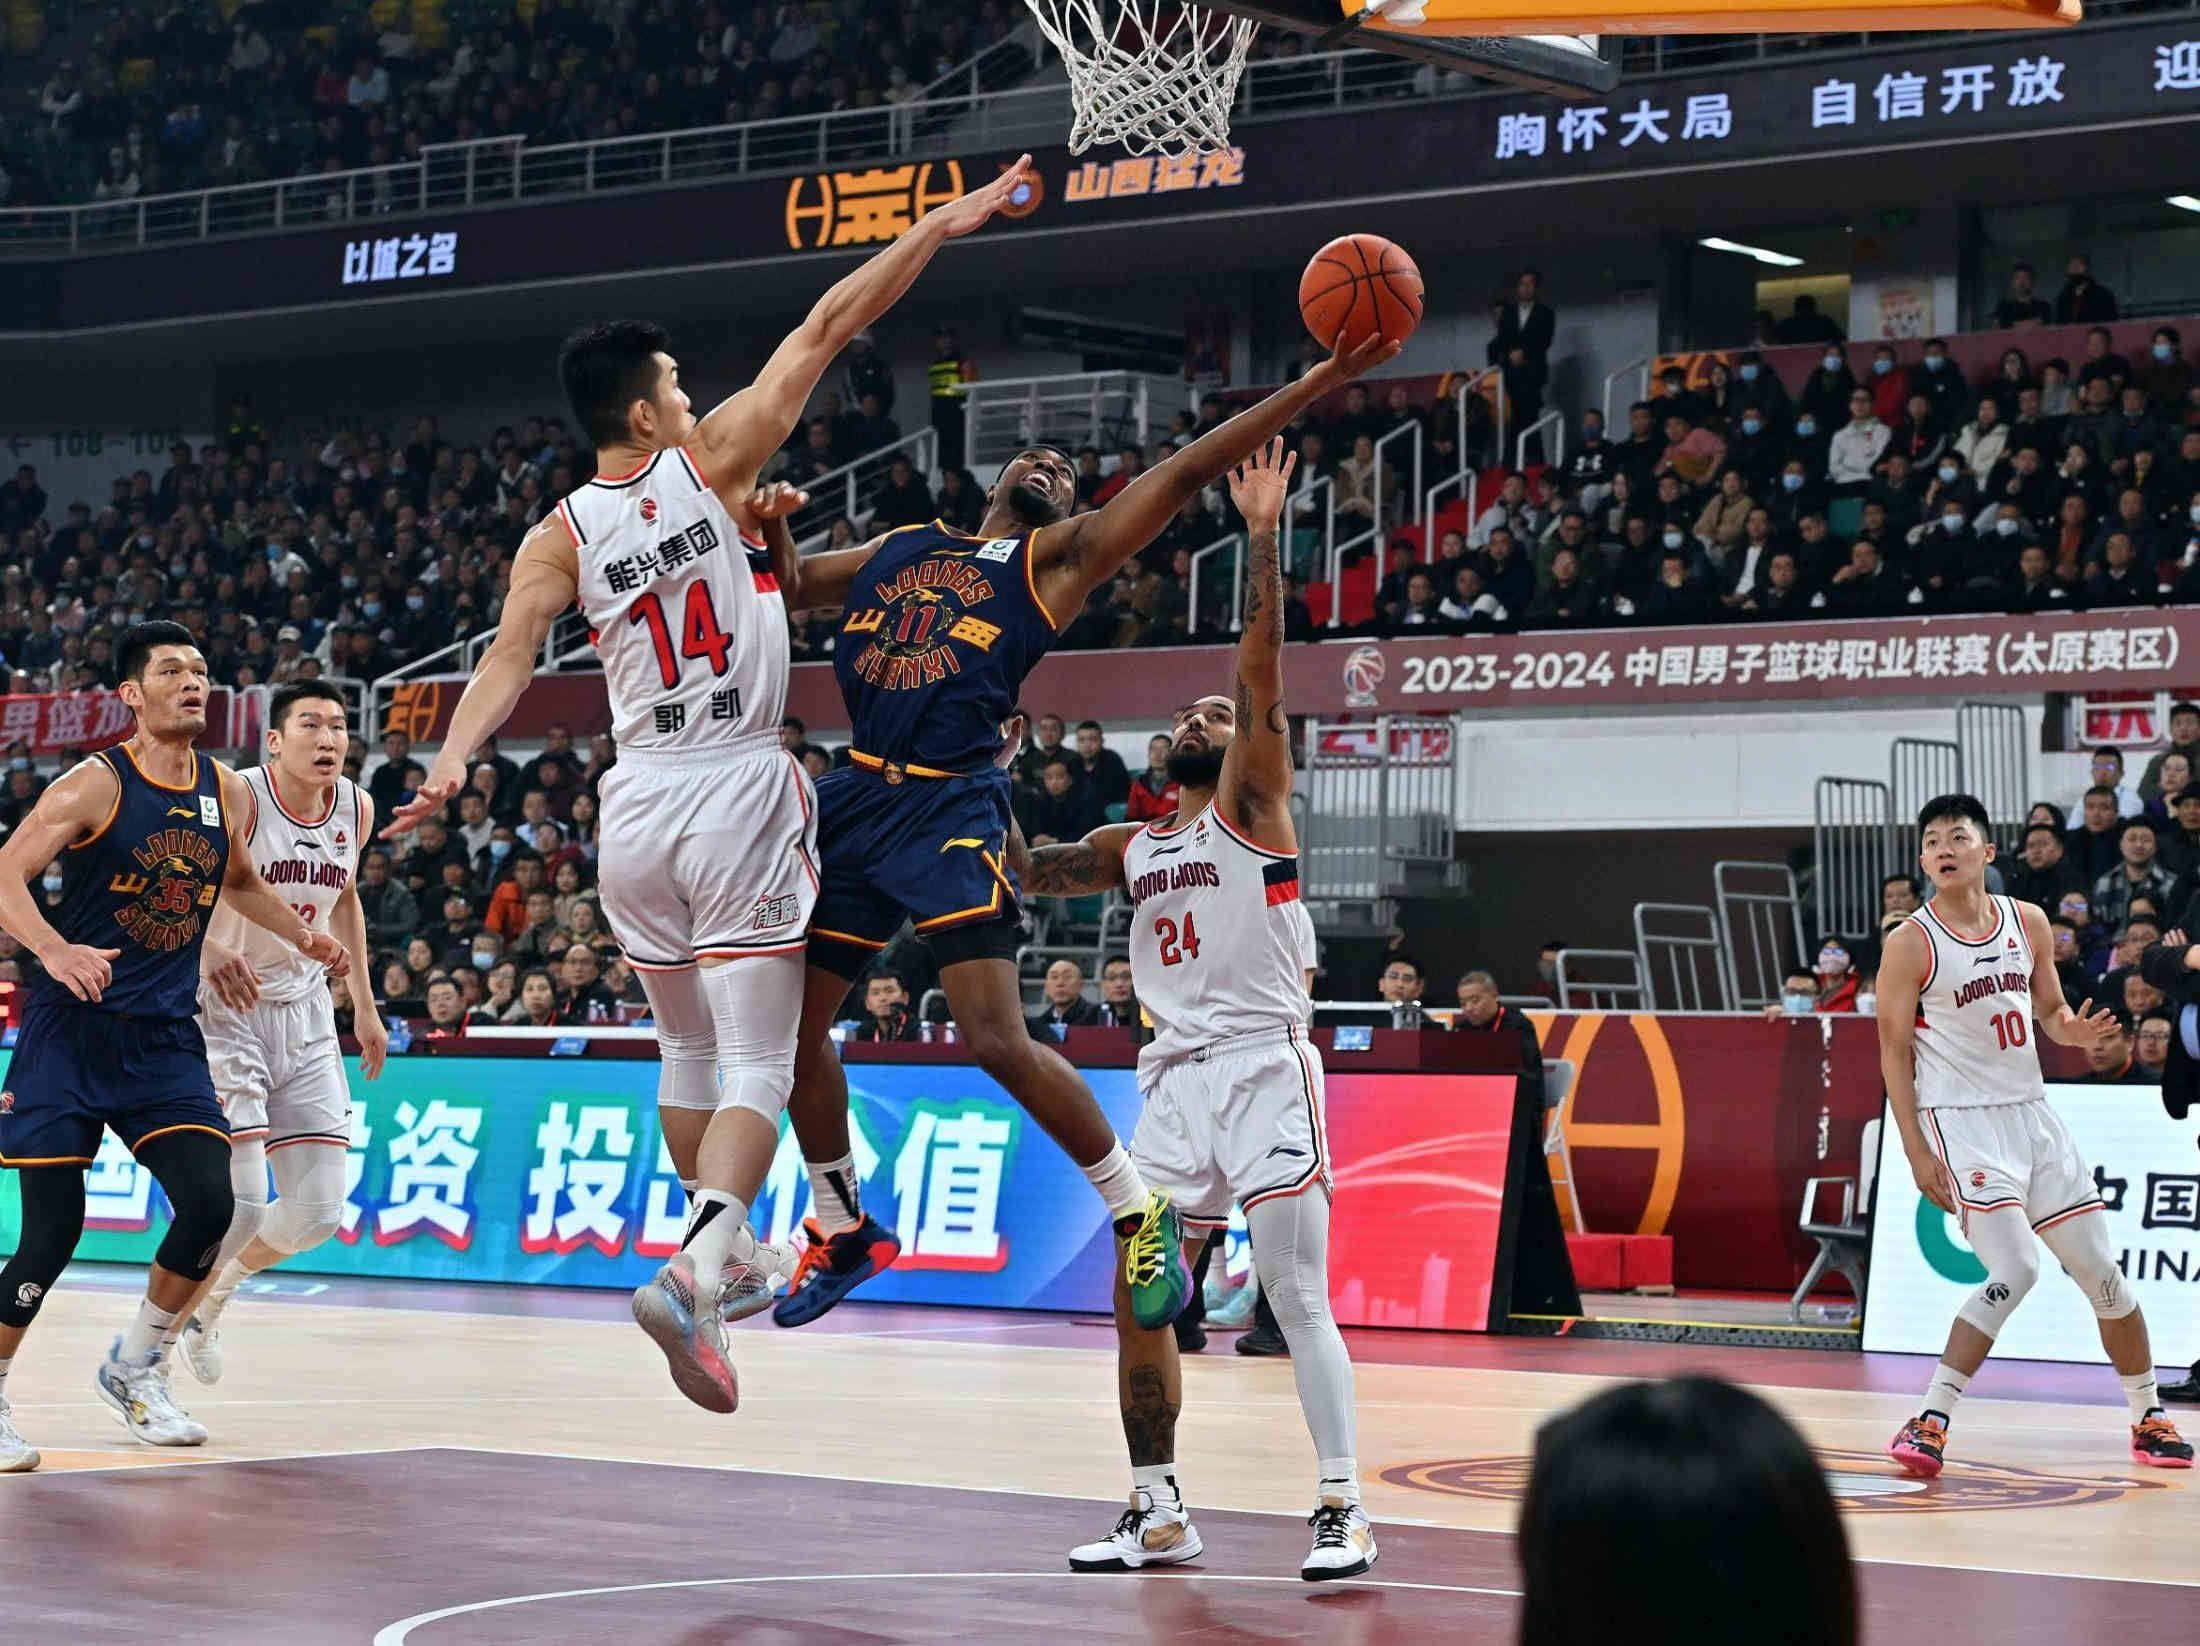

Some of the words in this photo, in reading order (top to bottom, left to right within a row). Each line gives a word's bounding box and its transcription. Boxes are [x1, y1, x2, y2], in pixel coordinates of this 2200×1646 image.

[1496, 93, 1733, 160] 胸怀大局
[1811, 55, 2066, 128] 自信开放
[2153, 40, 2200, 91] 迎
[342, 231, 458, 284] 以城之名
[875, 559, 996, 608] LOONGS
[629, 578, 734, 691] 14
[896, 605, 937, 643] 11
[853, 644, 961, 690] SHANXI
[1401, 651, 1616, 695] 2023-2024
[131, 828, 219, 877] LOONGS
[151, 878, 196, 914] 35
[1128, 868, 1169, 912] OONG
[1154, 911, 1201, 967] 24
[1990, 1010, 2027, 1051] 10
